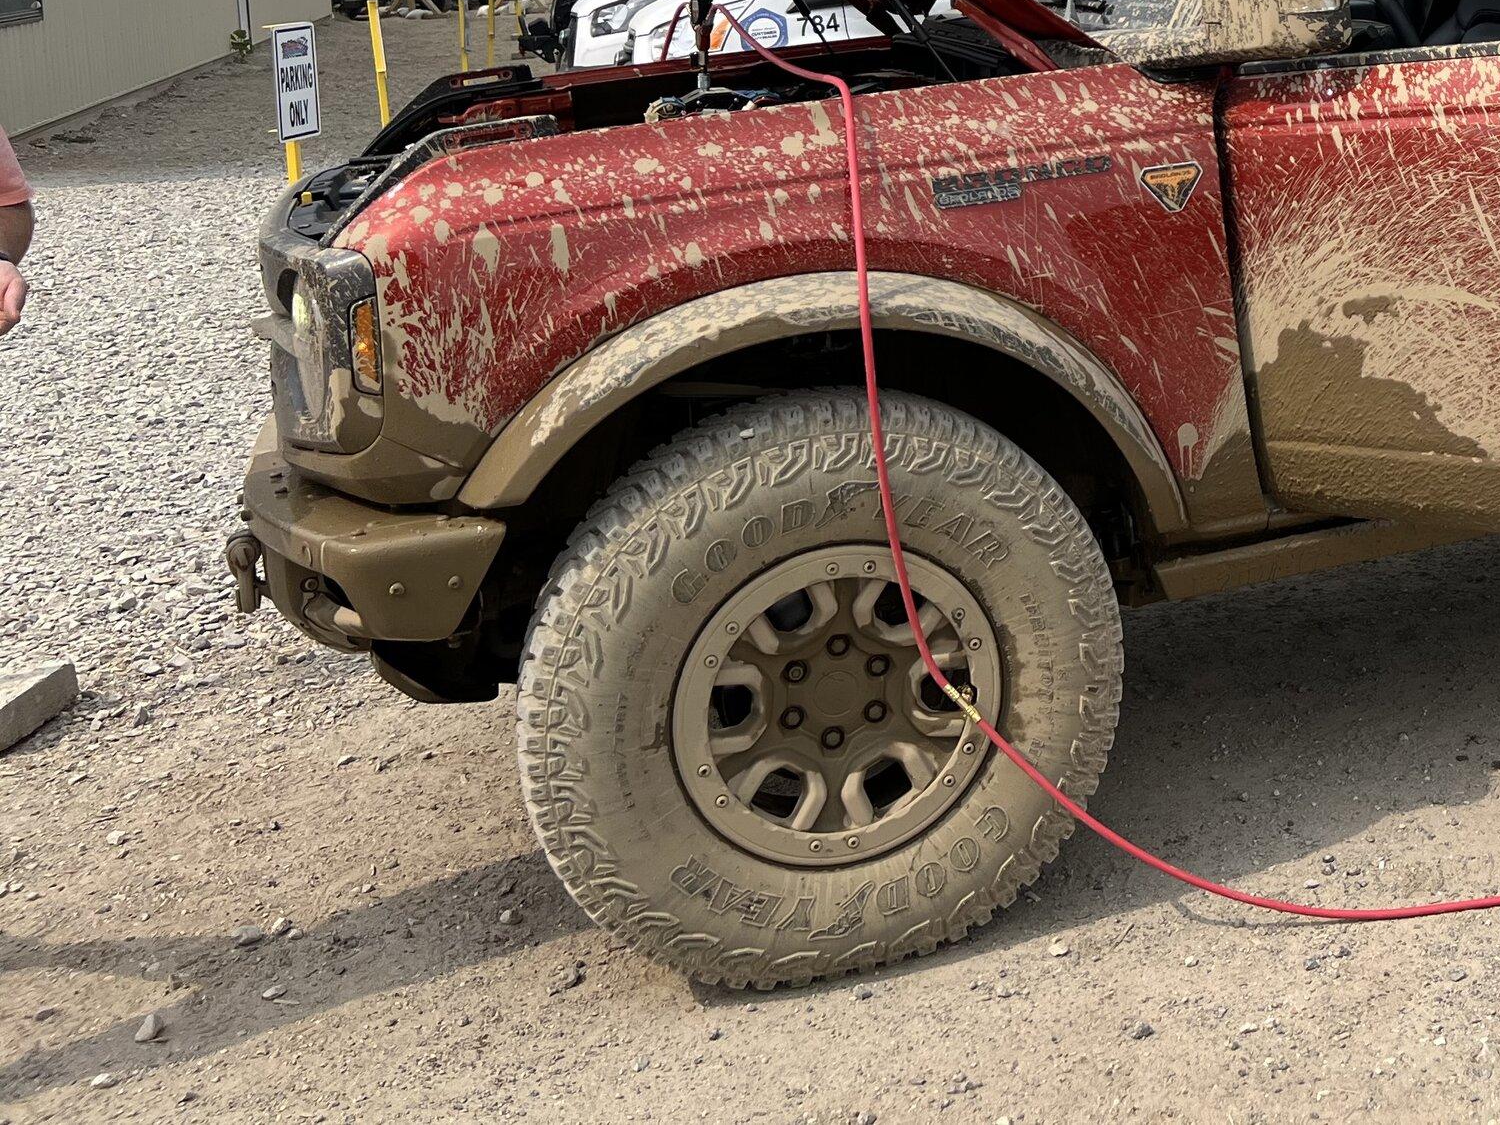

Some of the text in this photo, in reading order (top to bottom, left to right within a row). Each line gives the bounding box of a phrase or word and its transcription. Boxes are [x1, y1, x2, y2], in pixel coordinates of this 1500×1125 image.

[797, 12, 840, 37] 784
[280, 62, 313, 94] PARKING
[289, 98, 309, 129] ONLY
